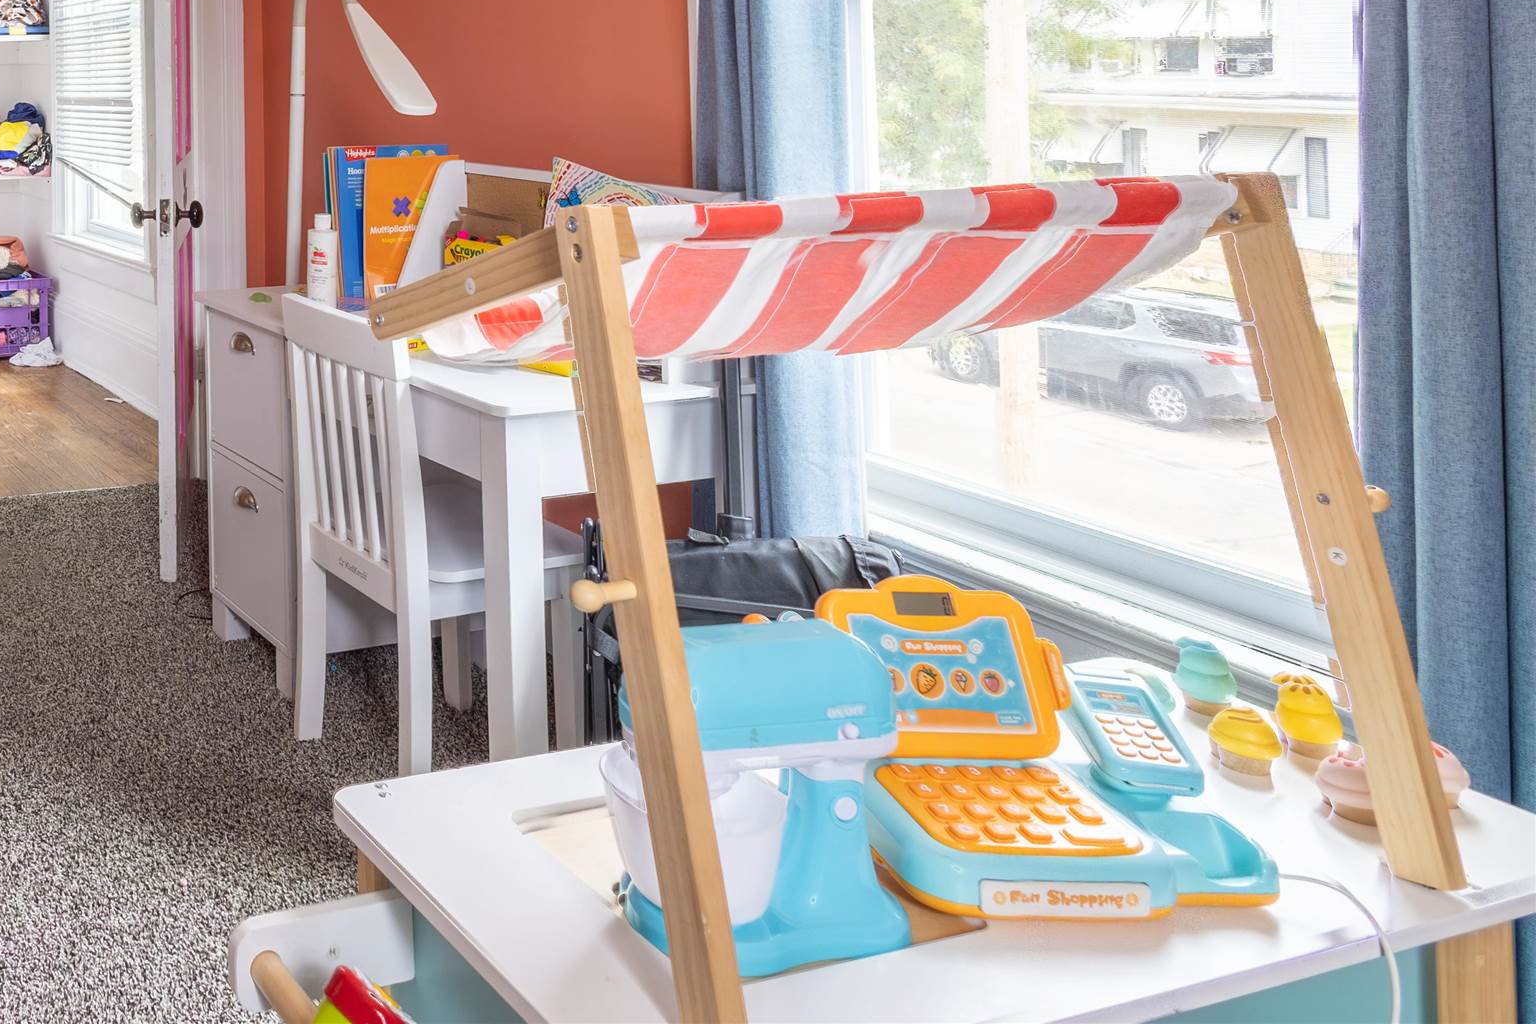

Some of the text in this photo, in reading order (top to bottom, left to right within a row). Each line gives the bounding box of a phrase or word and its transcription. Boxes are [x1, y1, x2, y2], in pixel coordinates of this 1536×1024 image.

[345, 147, 376, 159] Highlights
[1009, 889, 1125, 908] Fun Shopping
